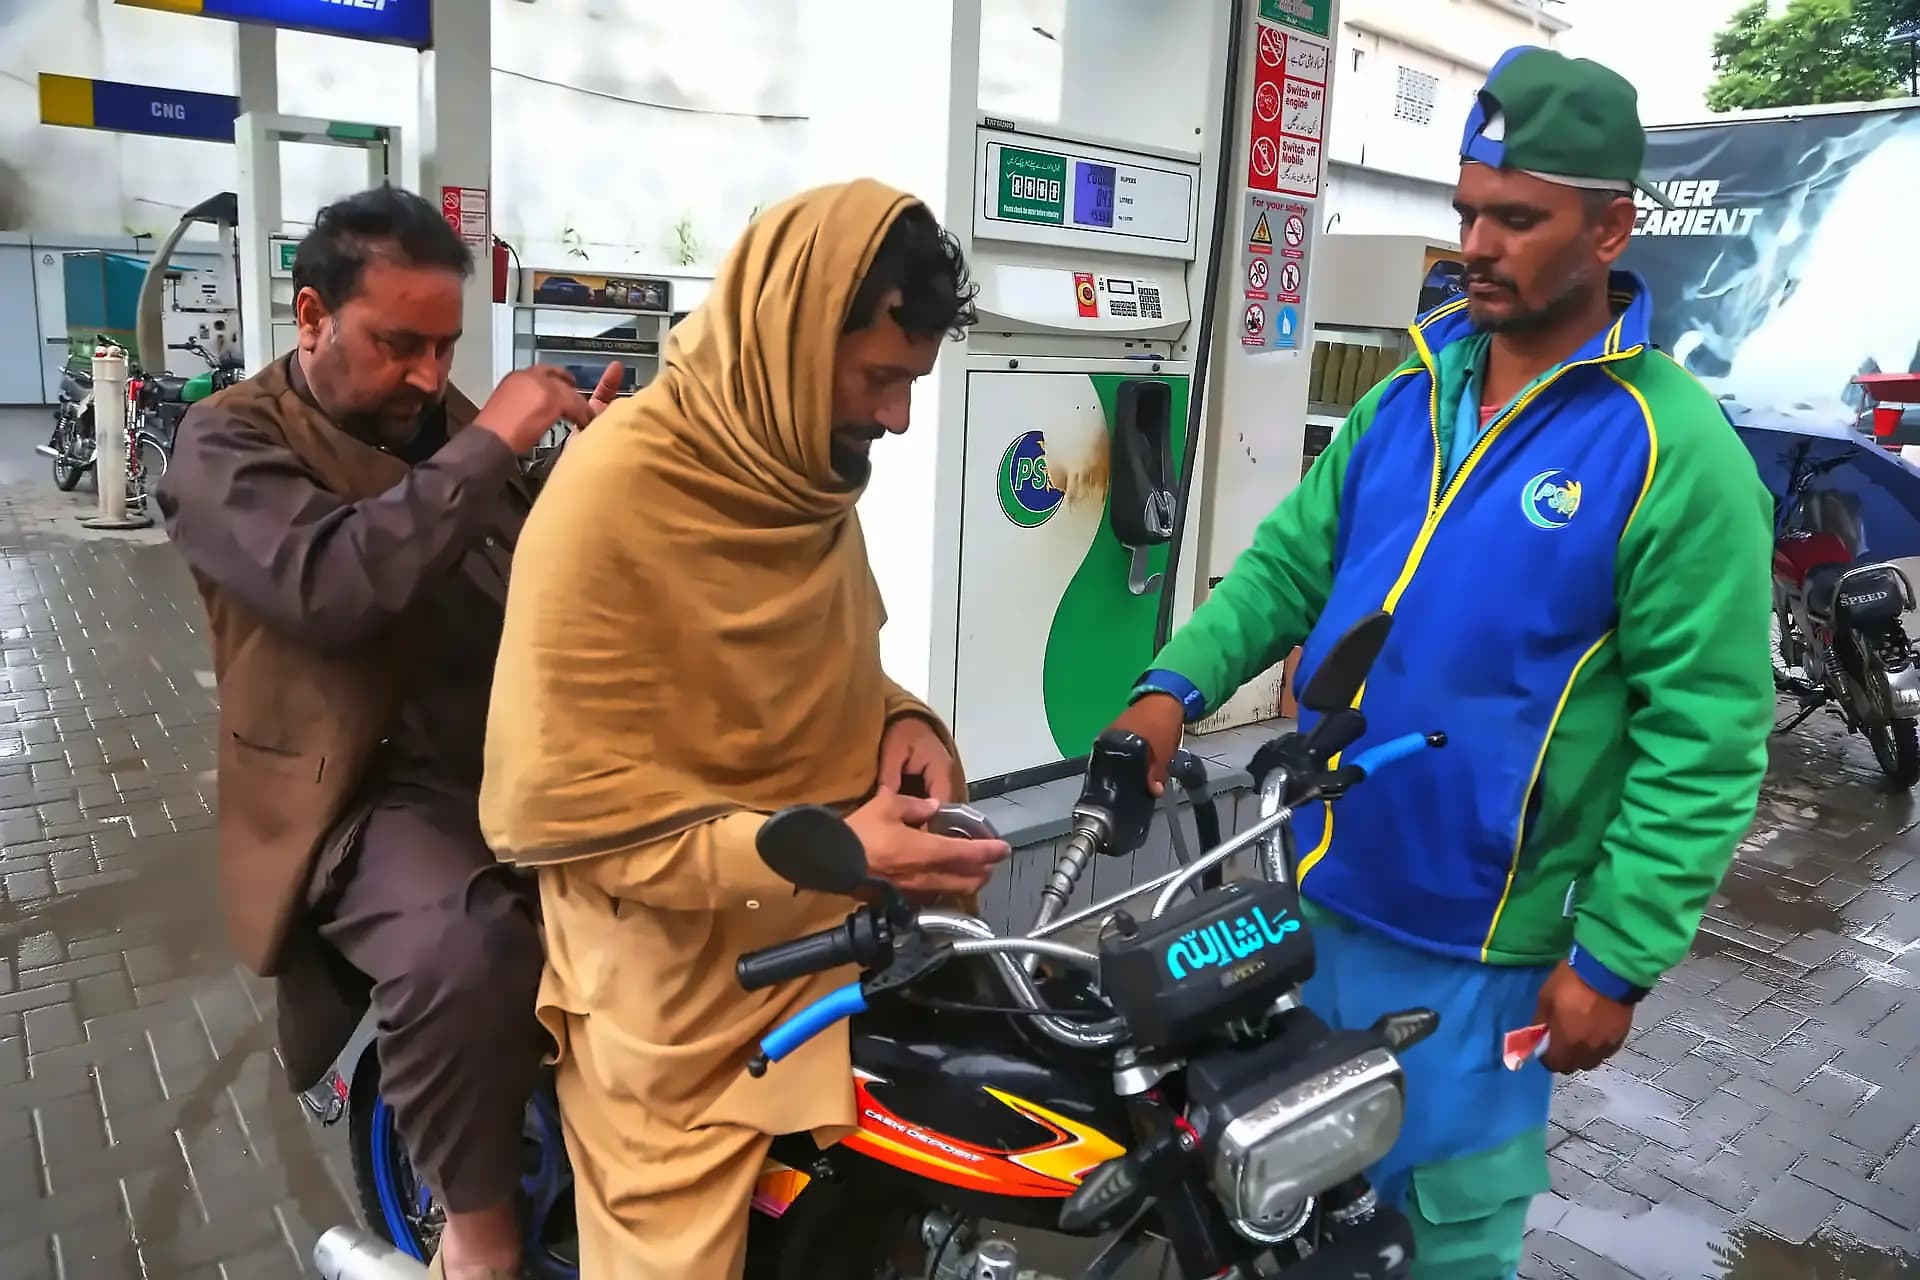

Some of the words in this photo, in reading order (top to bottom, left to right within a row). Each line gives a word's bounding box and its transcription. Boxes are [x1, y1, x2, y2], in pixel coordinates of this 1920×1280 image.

[1286, 83, 1310, 98] Switch
[1311, 90, 1321, 101] off
[151, 101, 185, 120] CNG
[1285, 97, 1309, 110] engine
[1282, 141, 1305, 155] Switch
[1306, 146, 1317, 156] off
[1281, 151, 1304, 165] Mobile
[1252, 196, 1264, 207] For
[1840, 591, 1888, 607] SPEED
